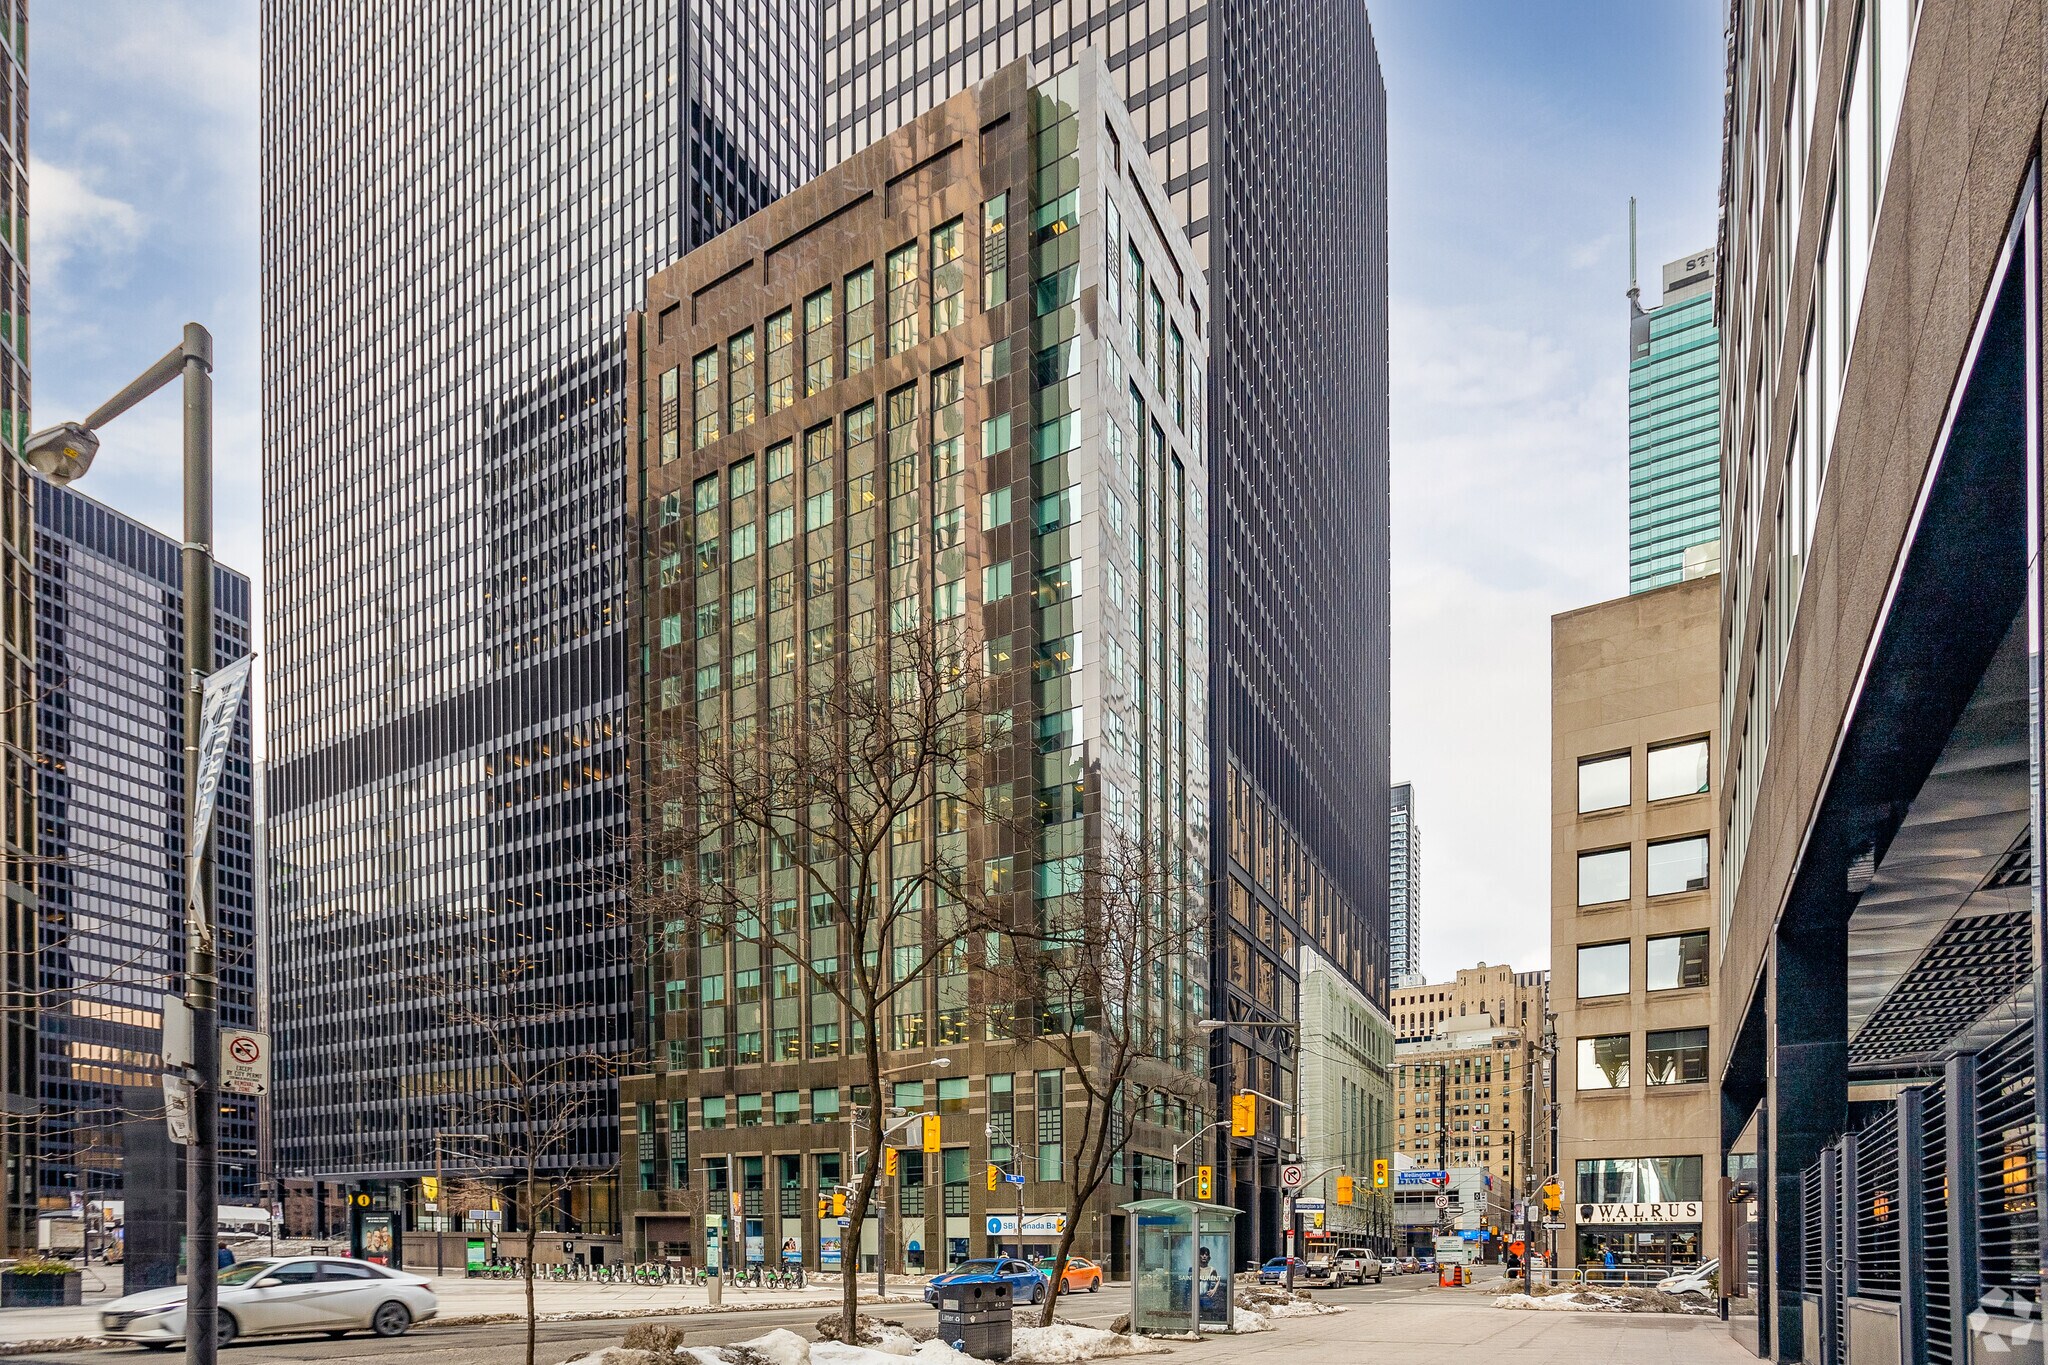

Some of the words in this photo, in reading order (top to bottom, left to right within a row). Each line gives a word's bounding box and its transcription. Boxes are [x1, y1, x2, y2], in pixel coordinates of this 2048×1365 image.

[1403, 1171, 1431, 1179] Wellington
[1598, 1203, 1697, 1218] WALRUS
[1003, 1222, 1016, 1230] SBI
[1022, 1222, 1045, 1230] anada
